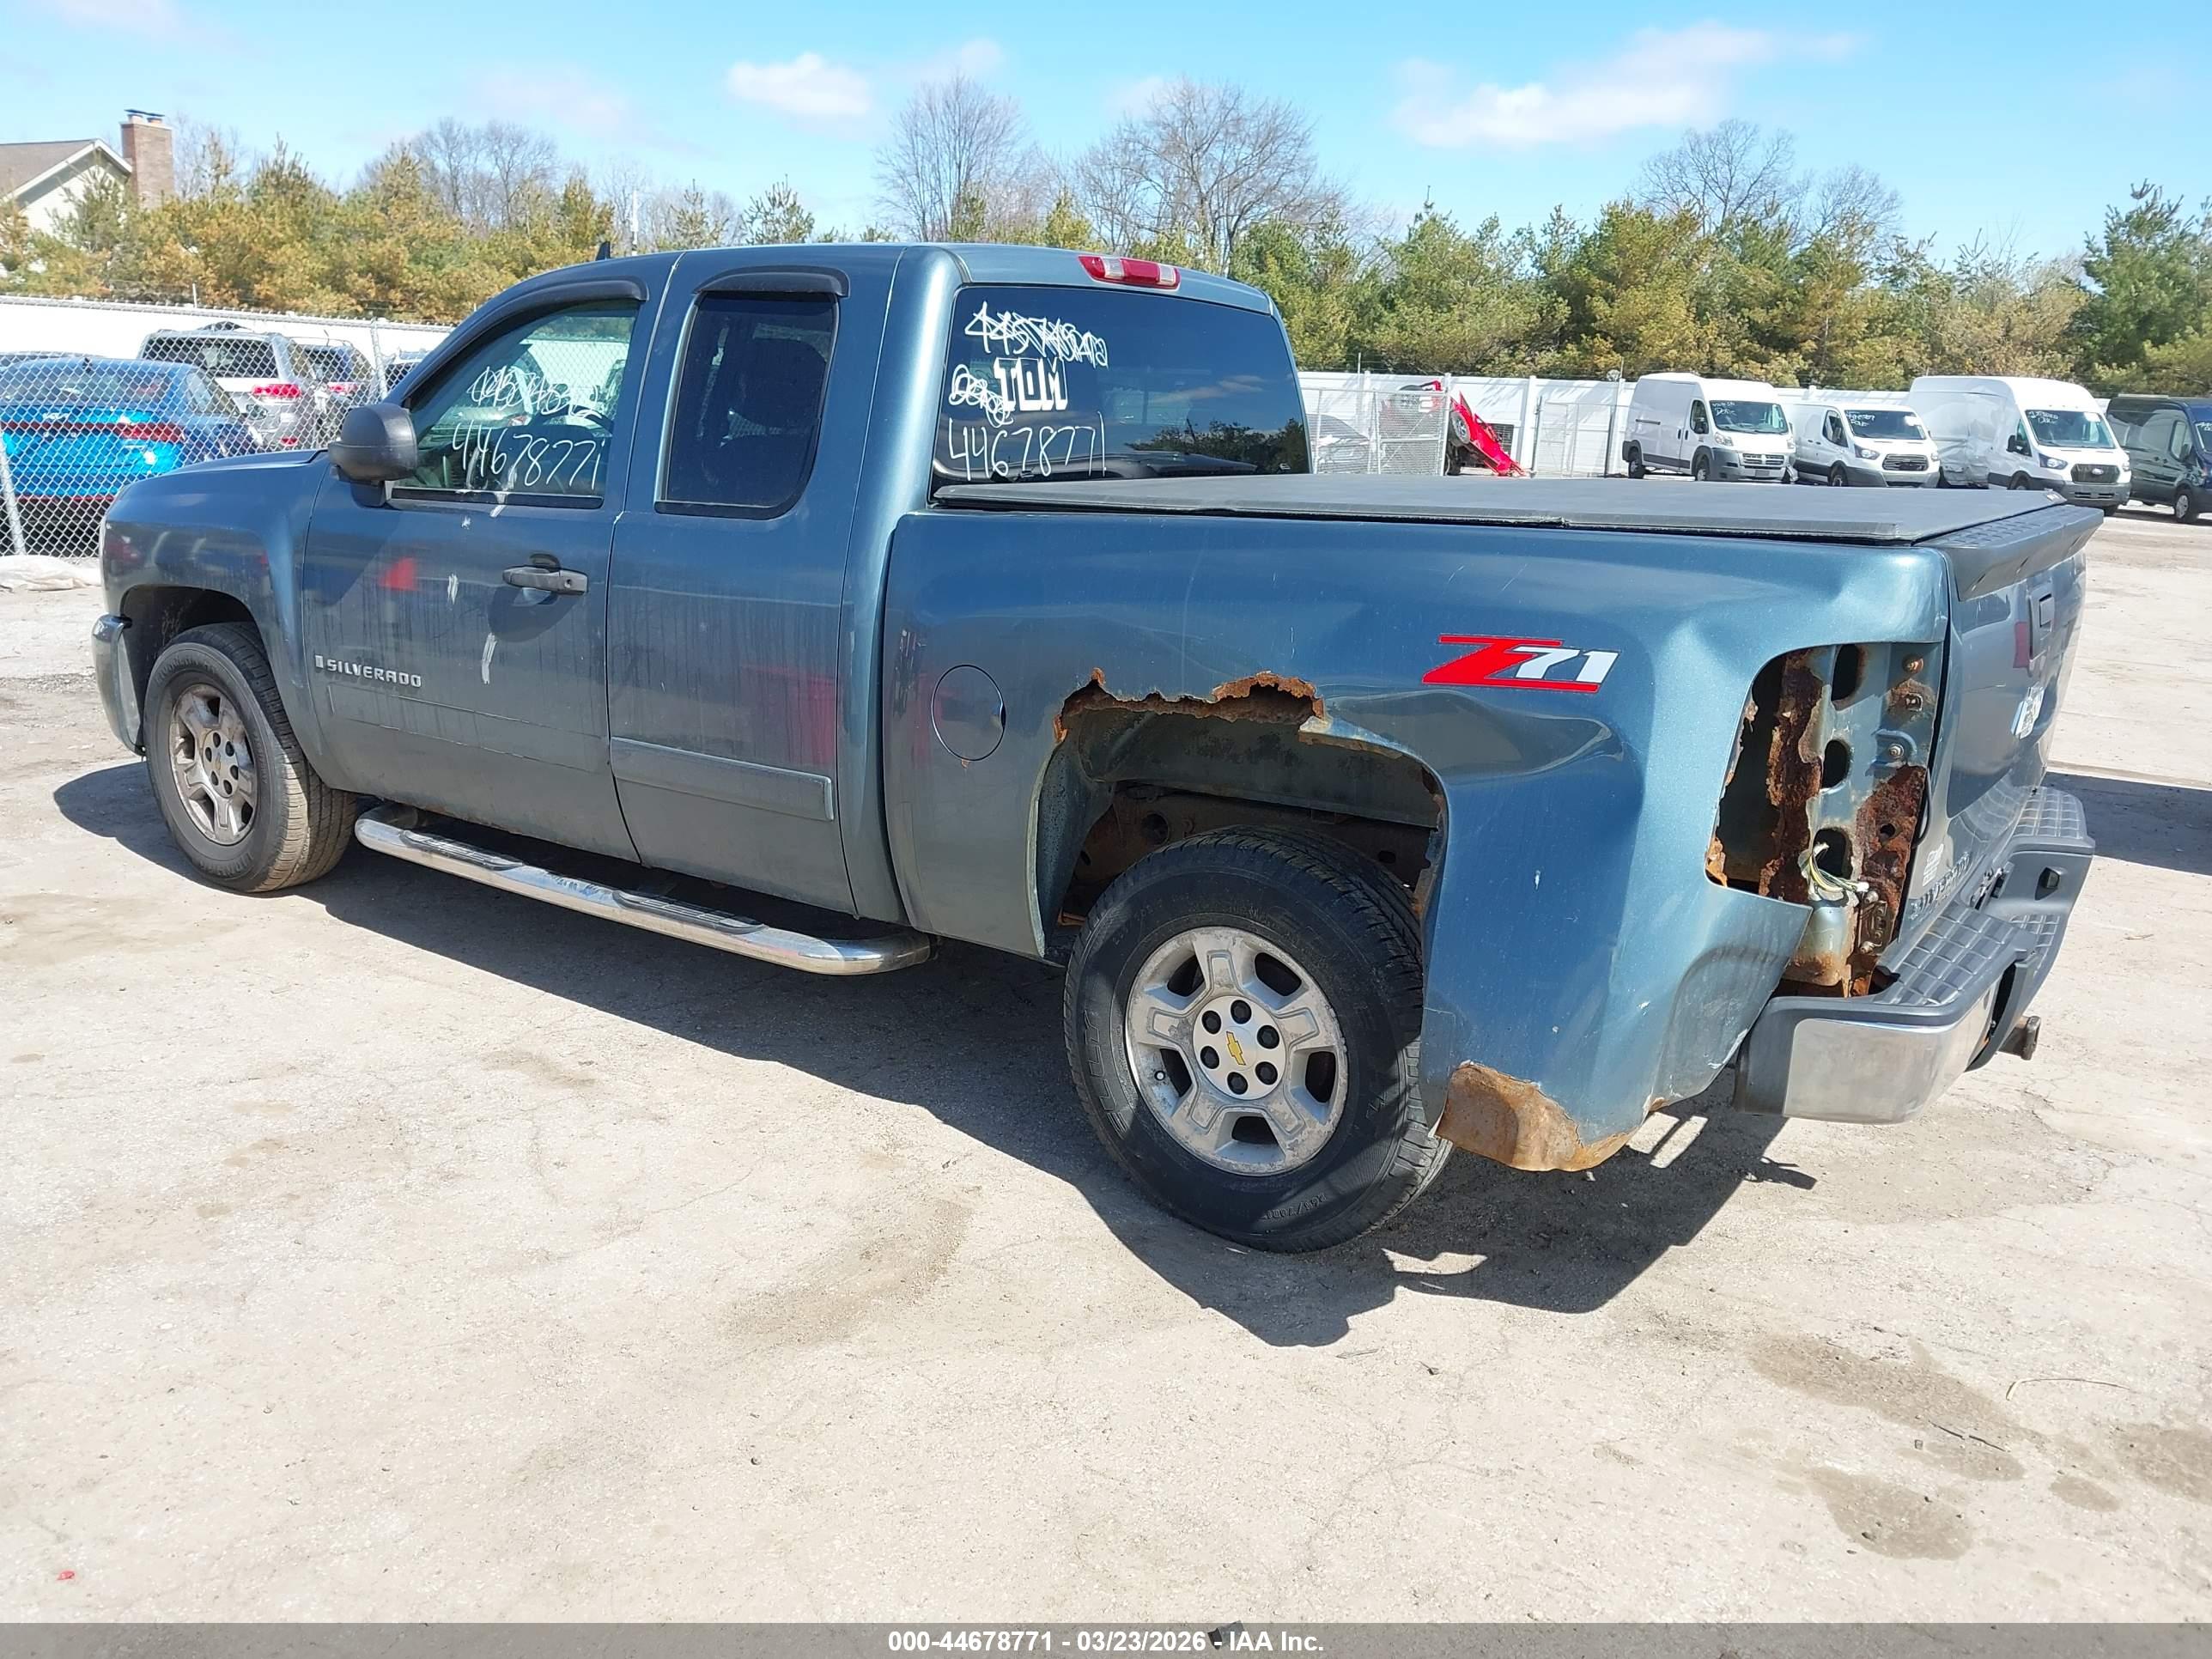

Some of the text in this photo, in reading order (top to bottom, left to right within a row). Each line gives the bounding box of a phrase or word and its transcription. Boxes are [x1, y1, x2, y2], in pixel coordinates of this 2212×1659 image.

[453, 420, 605, 490] 44678771
[948, 410, 1108, 482] 44678771
[326, 658, 422, 688] SILVERADO
[1422, 634, 1620, 693] Z71
